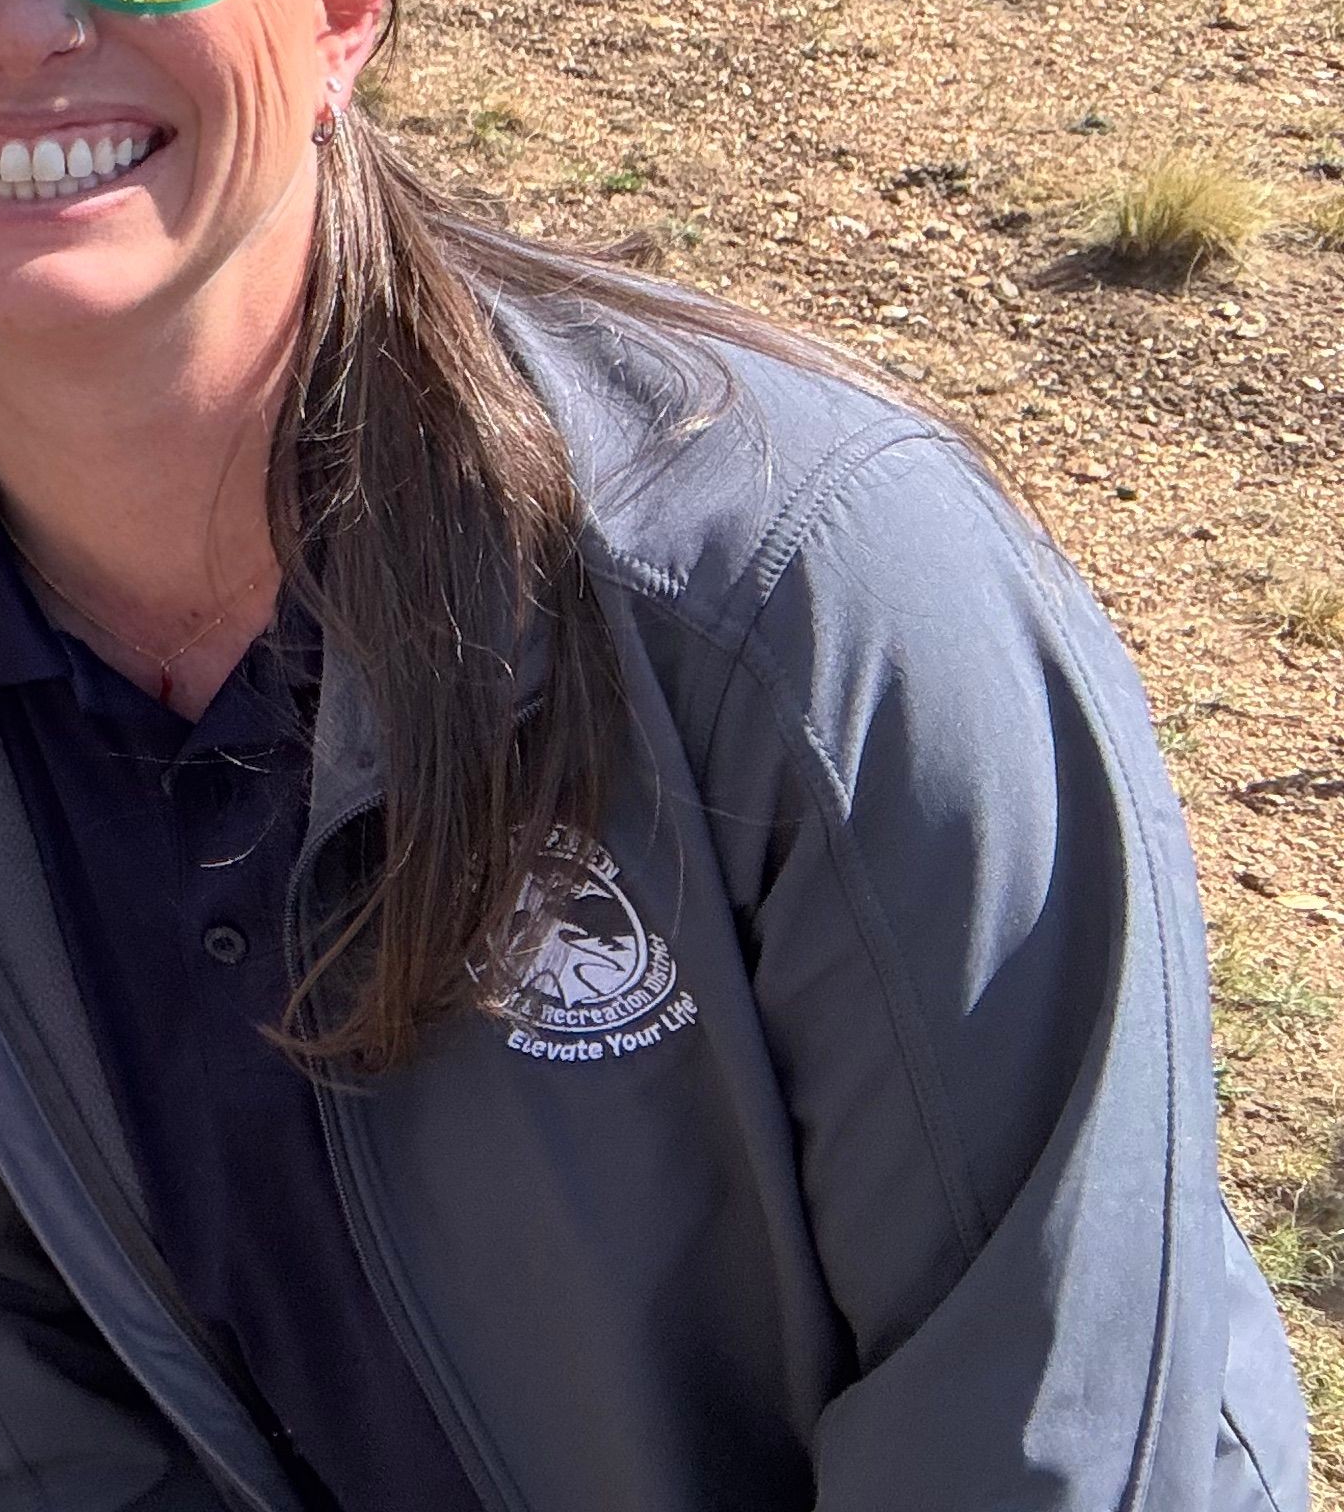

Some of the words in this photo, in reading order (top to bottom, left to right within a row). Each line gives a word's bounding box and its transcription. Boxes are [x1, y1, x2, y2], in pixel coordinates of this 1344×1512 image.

[540, 989, 653, 1026] Recreation
[643, 933, 670, 995] District
[506, 1028, 604, 1063] Elevate
[605, 1023, 662, 1057] Your
